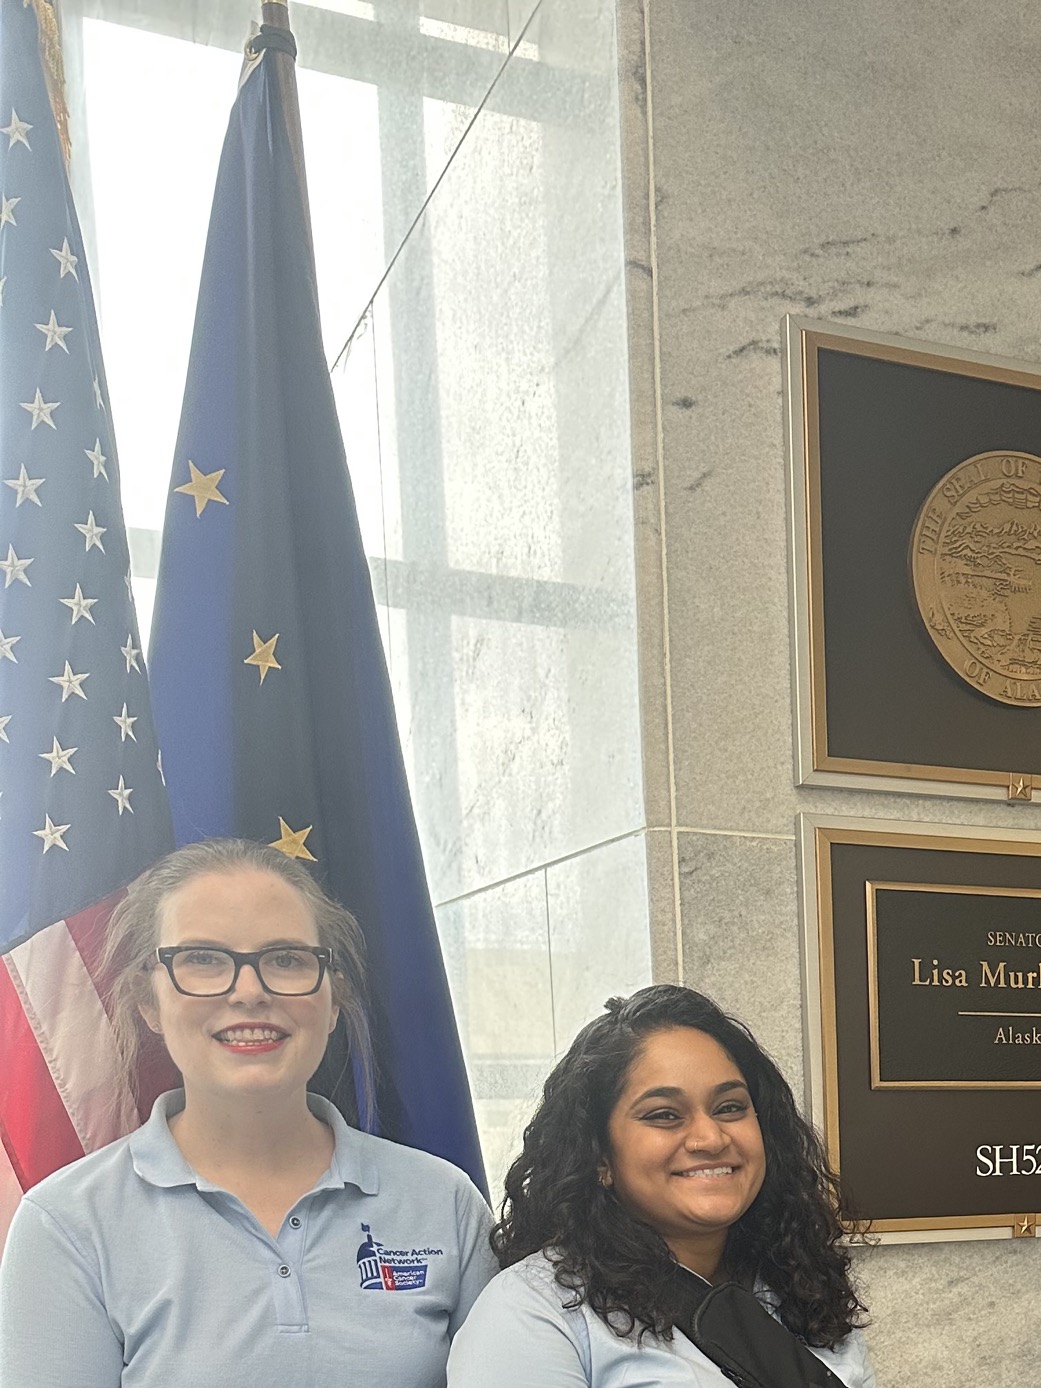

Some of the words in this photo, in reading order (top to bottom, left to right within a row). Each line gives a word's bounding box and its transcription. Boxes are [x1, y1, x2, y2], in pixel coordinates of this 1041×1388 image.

[919, 508, 944, 555] THE
[942, 463, 990, 506] SEAL
[1001, 458, 1028, 479] OF
[963, 660, 992, 686] OF
[911, 958, 969, 988] Lisa
[377, 1248, 409, 1257] Cancer
[411, 1247, 444, 1256] Action
